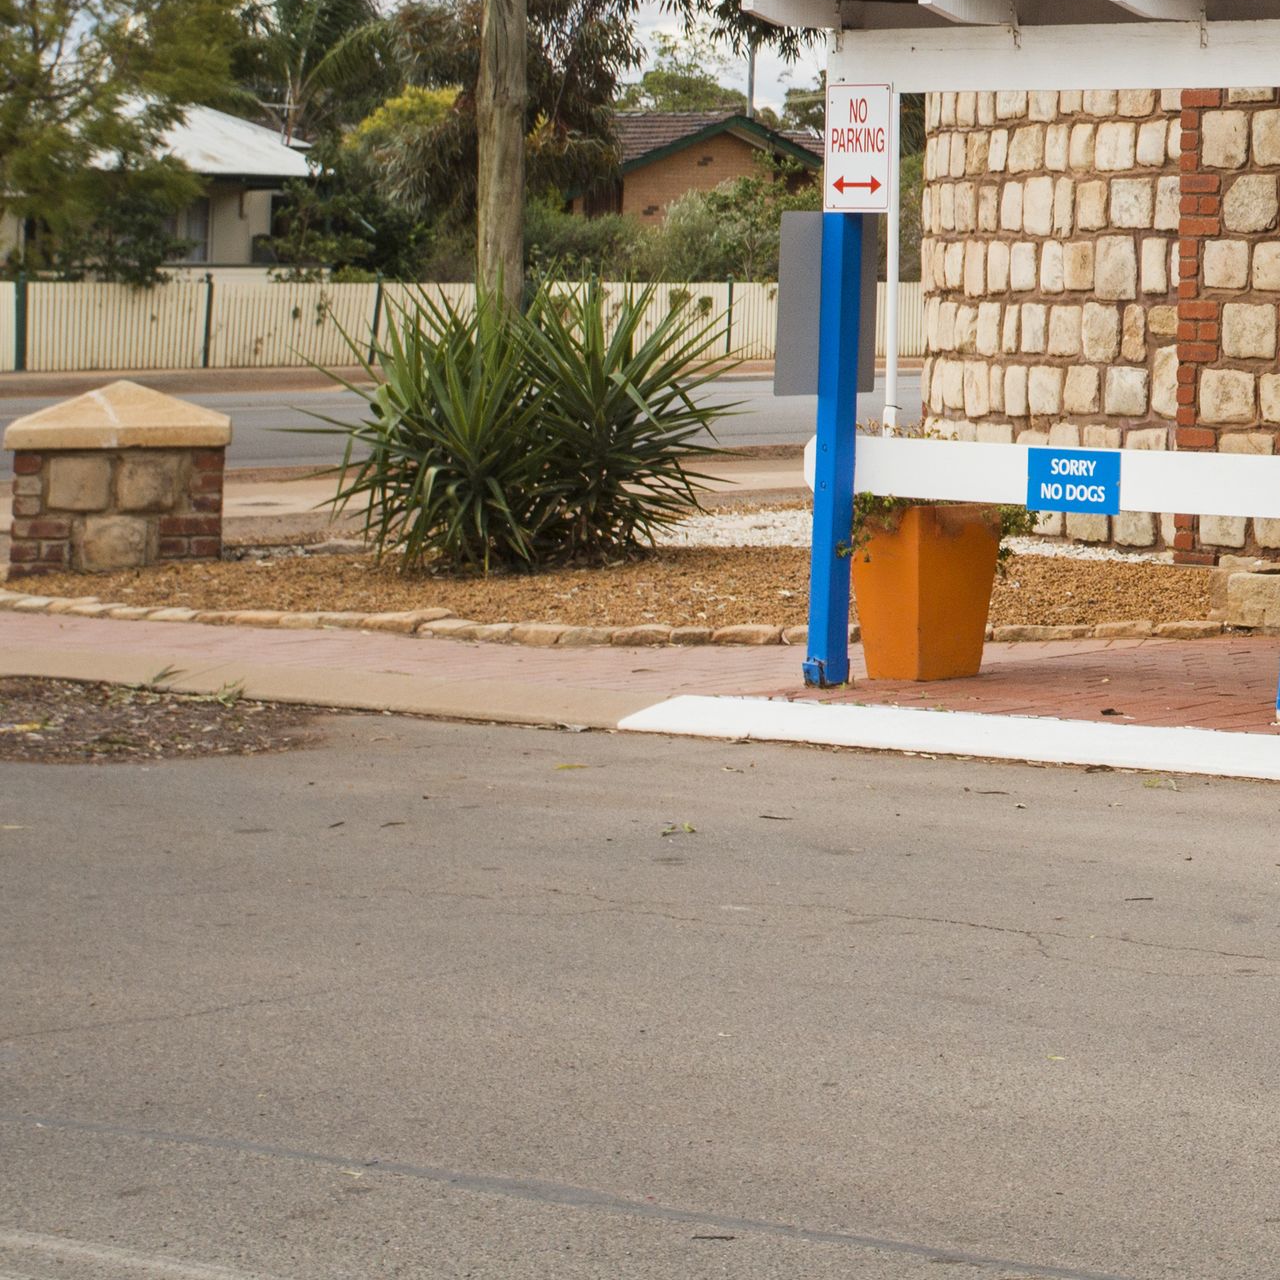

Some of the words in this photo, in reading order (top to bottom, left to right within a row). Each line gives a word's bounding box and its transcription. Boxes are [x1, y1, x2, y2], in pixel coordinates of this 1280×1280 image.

[849, 98, 868, 123] NO
[831, 127, 885, 153] PARKING
[1051, 458, 1096, 476] SORRY
[1041, 483, 1062, 500] NO
[1066, 484, 1105, 502] DOGS
